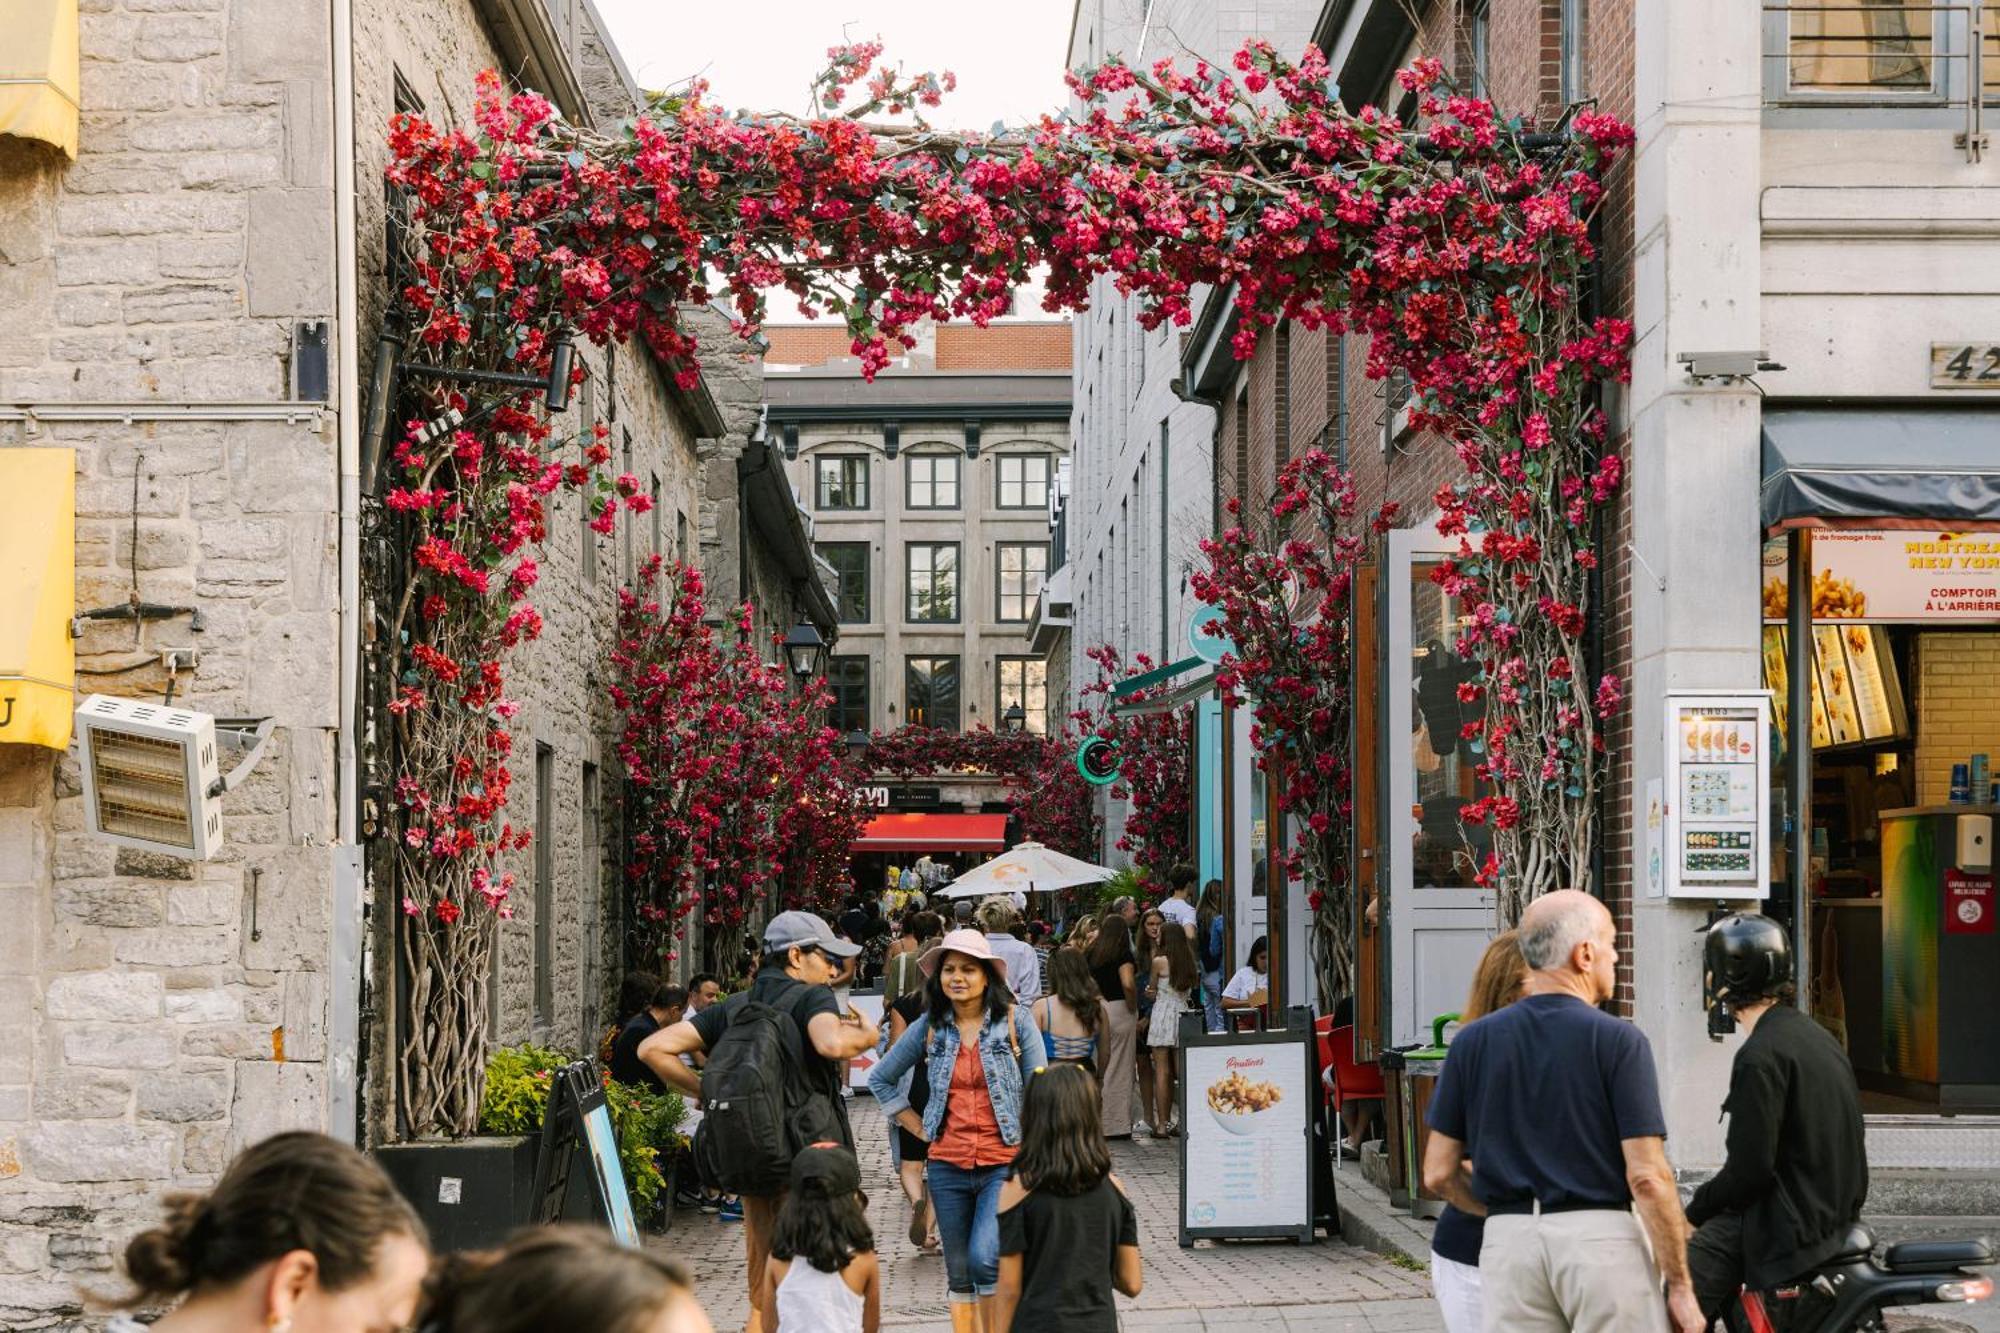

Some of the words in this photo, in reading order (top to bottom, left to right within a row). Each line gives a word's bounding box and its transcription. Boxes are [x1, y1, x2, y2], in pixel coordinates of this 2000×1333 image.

[1830, 534, 1864, 542] fromage
[1909, 556, 1953, 569] NEW
[1930, 588, 1997, 598] COMPTOIR
[1925, 599, 1934, 611] À
